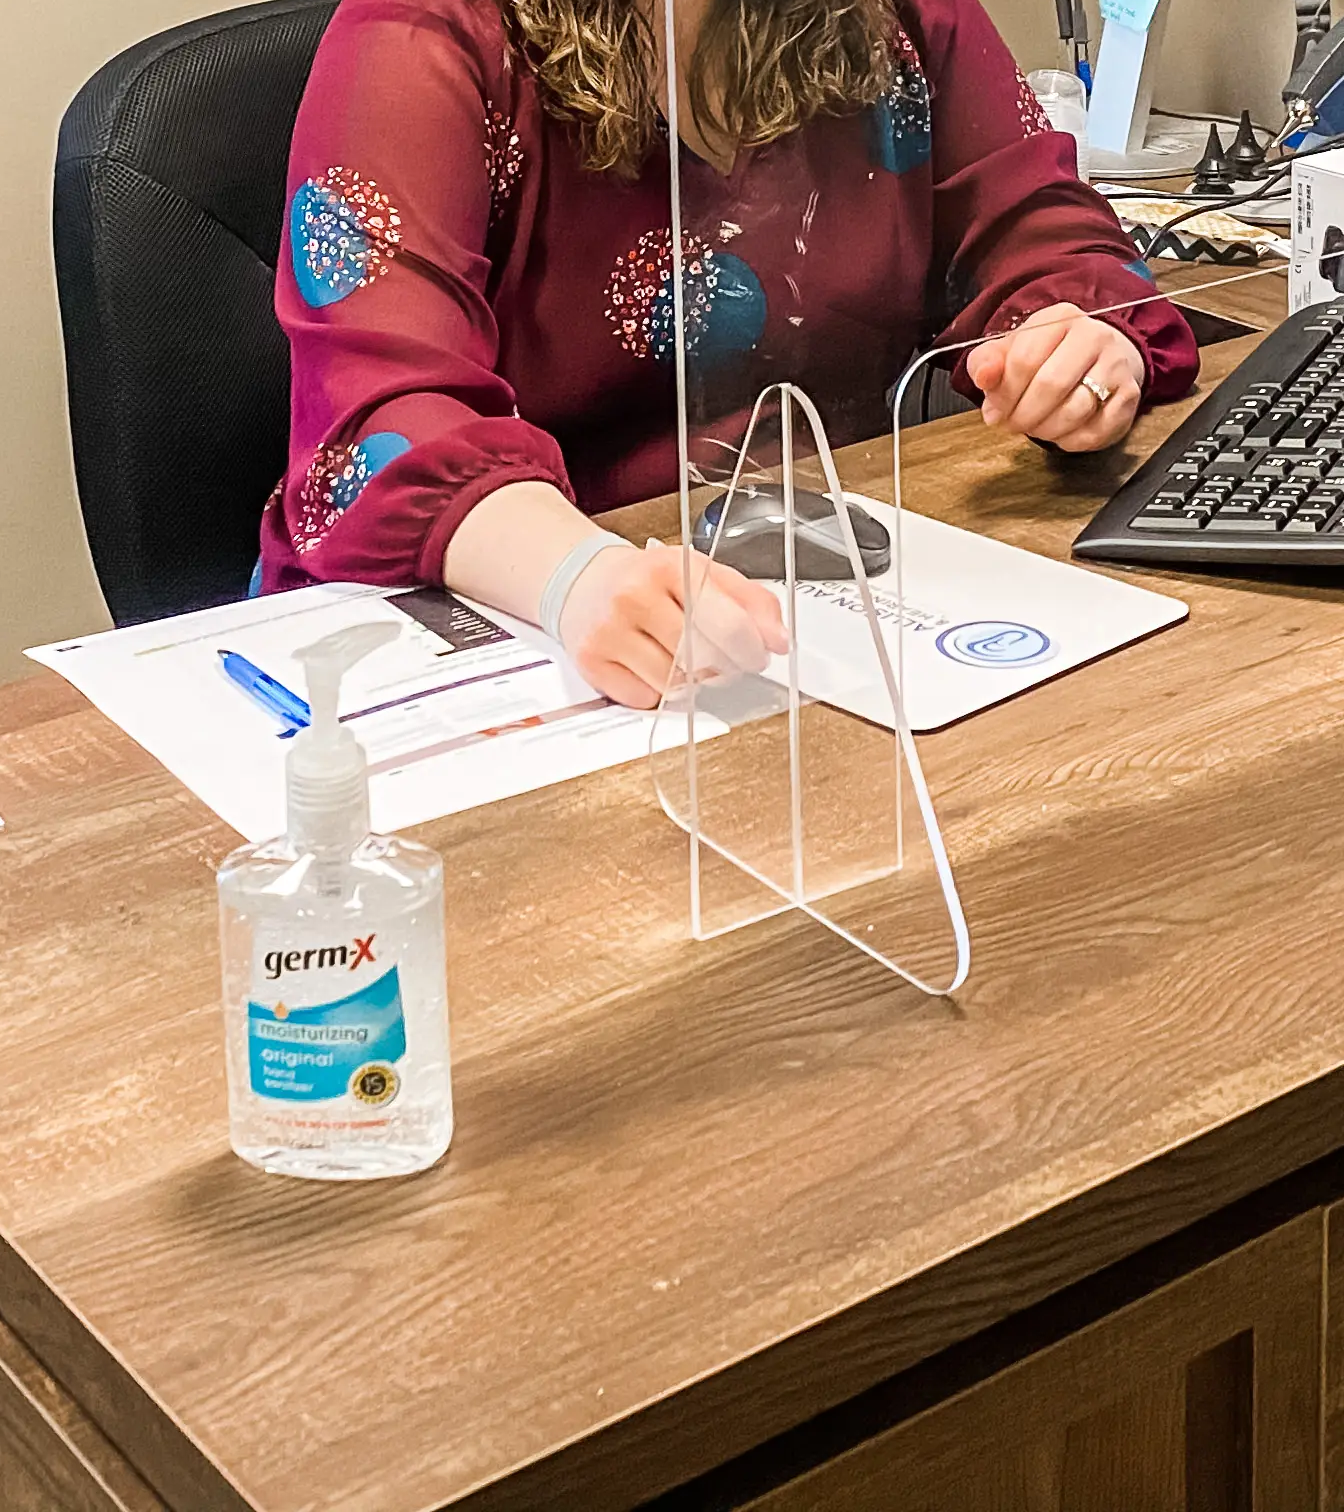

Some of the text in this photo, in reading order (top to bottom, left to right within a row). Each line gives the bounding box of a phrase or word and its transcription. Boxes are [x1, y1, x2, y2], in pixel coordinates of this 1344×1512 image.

[264, 932, 377, 980] germ-X
[259, 1022, 369, 1043] moisturizing
[261, 1048, 334, 1067] original
